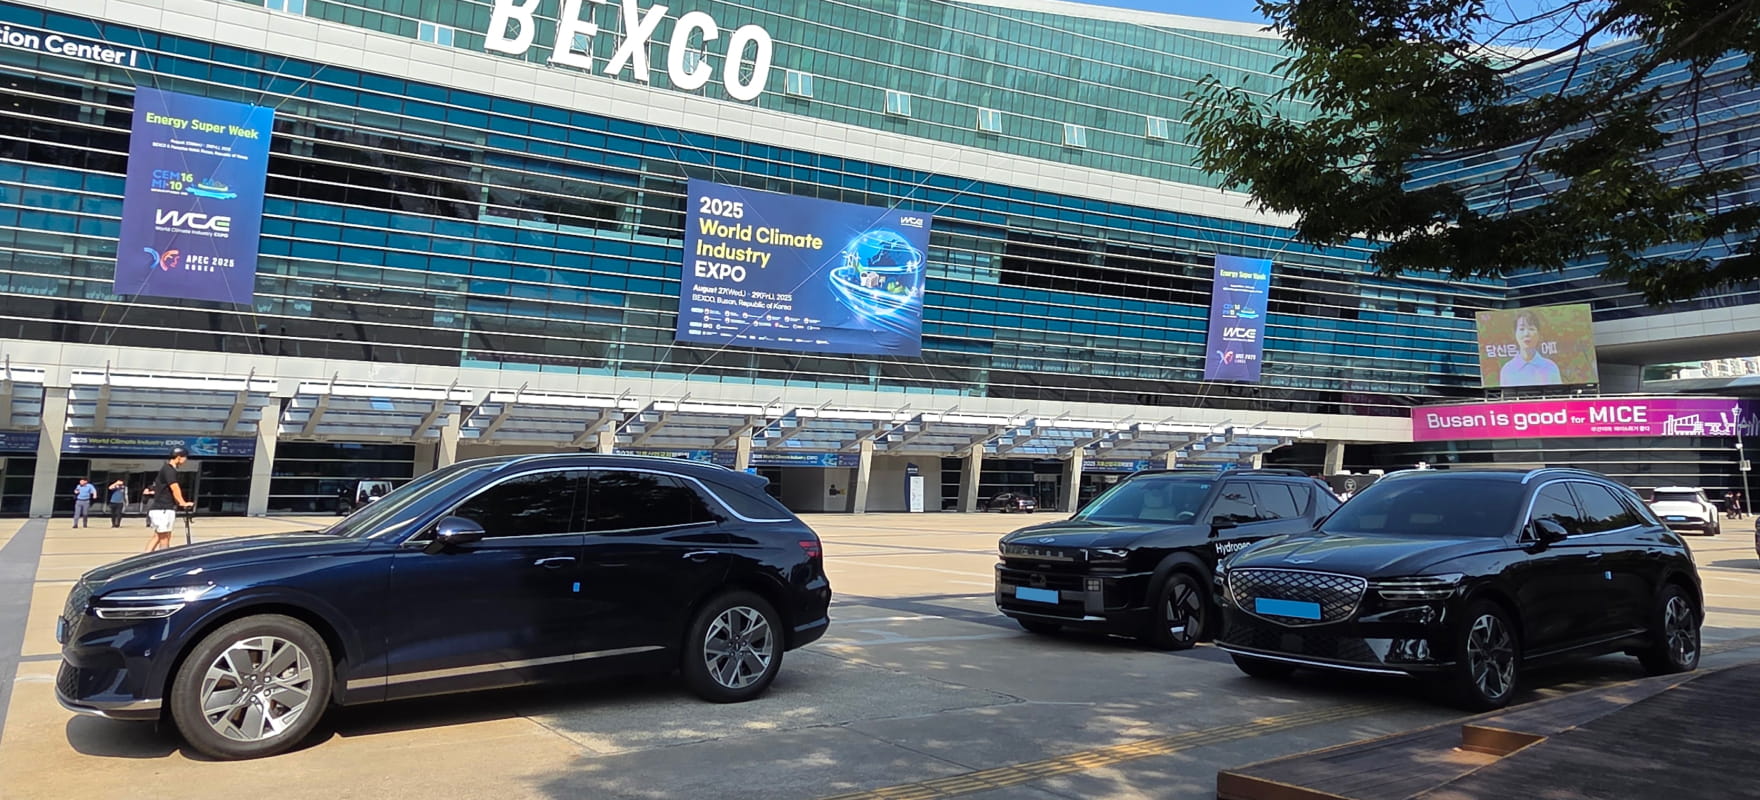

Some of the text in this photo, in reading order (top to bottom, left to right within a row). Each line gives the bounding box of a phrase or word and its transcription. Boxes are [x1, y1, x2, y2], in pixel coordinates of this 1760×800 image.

[45, 35, 126, 64] Center
[484, 0, 773, 101] BEXCO
[146, 112, 259, 139] Energy Super Week
[699, 196, 743, 219] 2025
[155, 209, 231, 232] WCE
[699, 217, 823, 250] World Climate
[186, 254, 235, 267] APEC 2025
[696, 239, 771, 269] Industry
[695, 260, 746, 283] EXPO
[692, 284, 717, 294] August
[776, 293, 792, 301] 2025
[738, 299, 765, 309] Republic
[773, 303, 792, 311] Korea
[1223, 327, 1256, 338] WCE
[1485, 343, 1520, 358] 당신은
[1427, 405, 1648, 431] Busan is good for MICE
[137, 439, 164, 447] Industry
